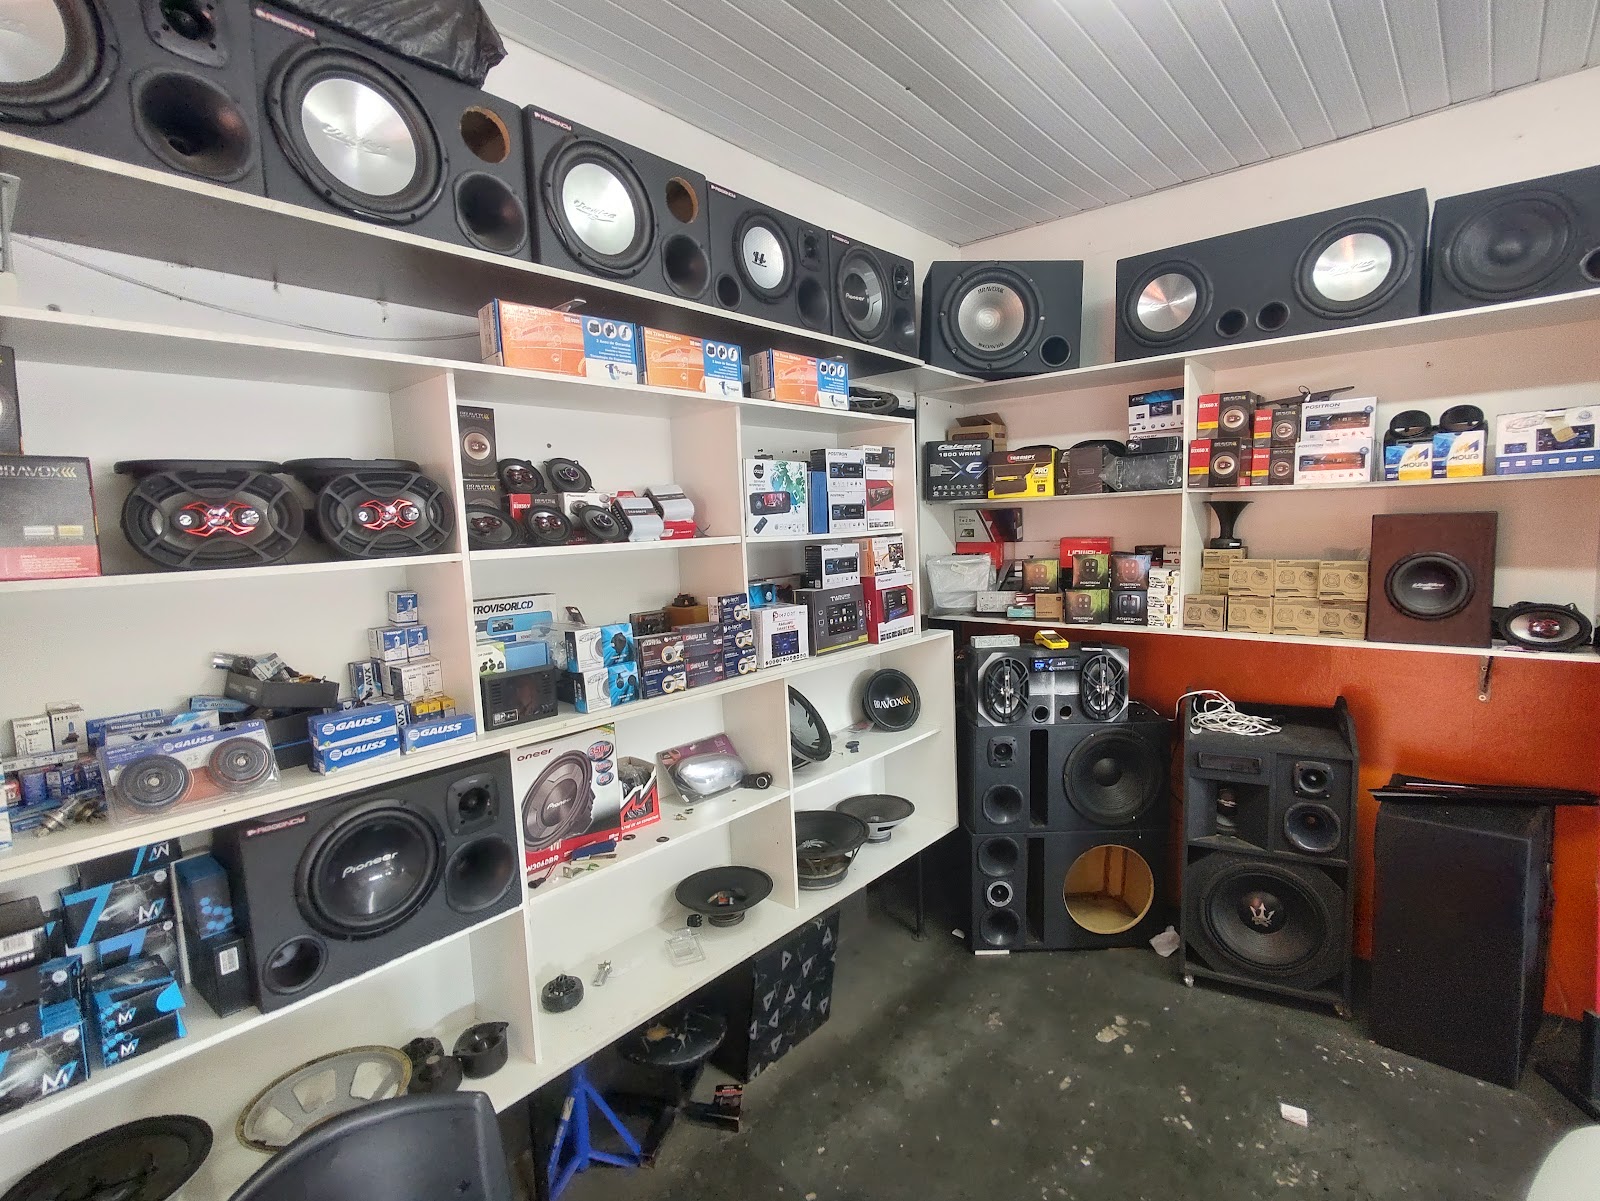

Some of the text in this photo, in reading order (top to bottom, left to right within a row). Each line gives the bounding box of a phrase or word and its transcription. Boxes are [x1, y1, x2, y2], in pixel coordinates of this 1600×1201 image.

[336, 715, 382, 731] GAUSS
[421, 722, 462, 737] GAUSS
[174, 734, 215, 749] GAUSS
[342, 739, 387, 757] GAUSS
[341, 851, 399, 879] Pioneer
